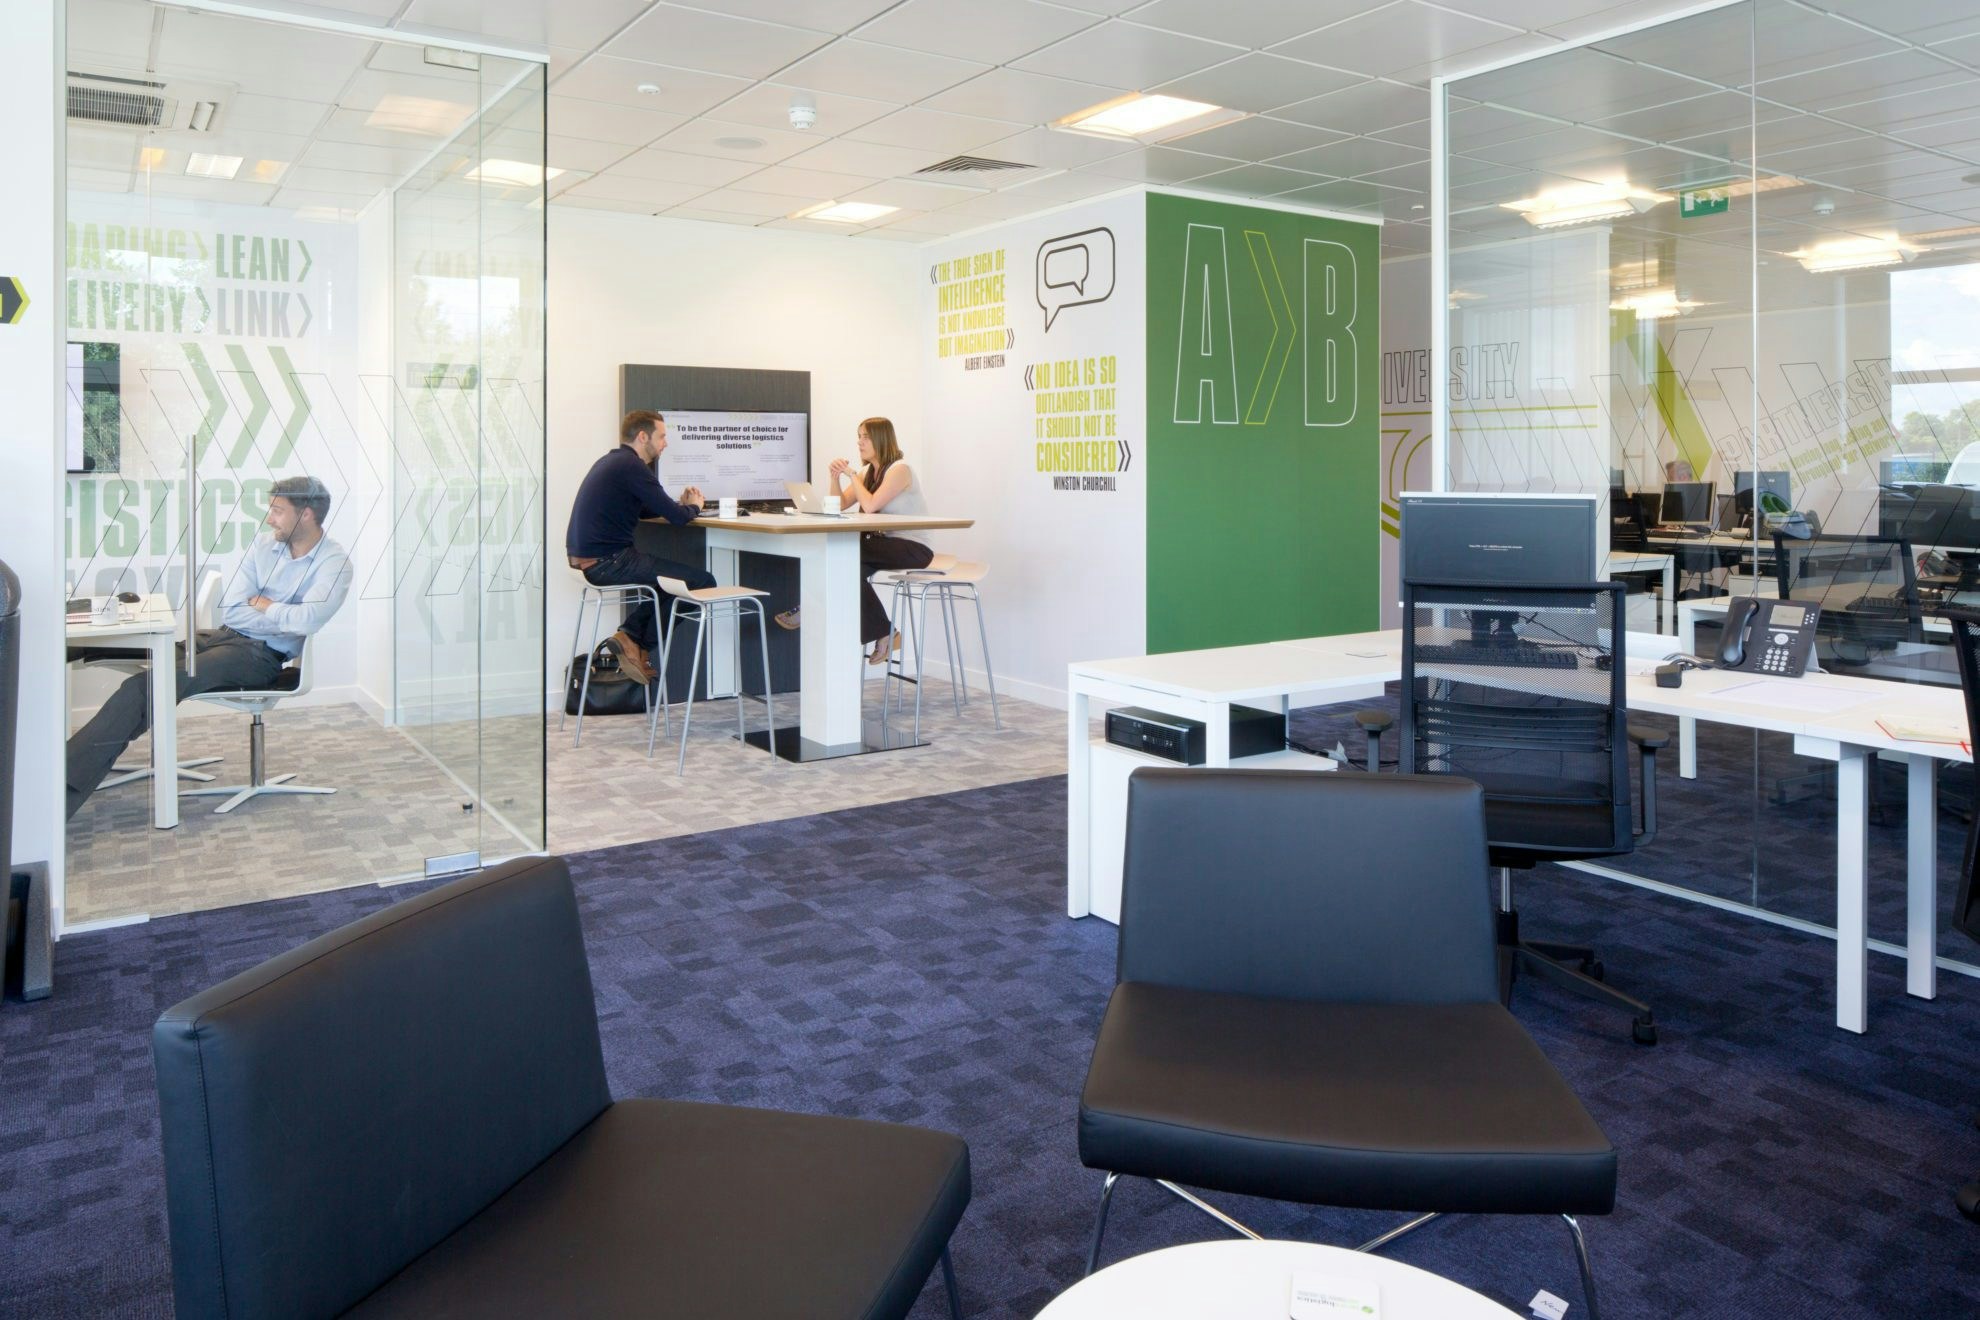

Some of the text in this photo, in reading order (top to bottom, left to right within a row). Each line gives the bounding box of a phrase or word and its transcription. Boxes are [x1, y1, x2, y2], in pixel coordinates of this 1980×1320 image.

[216, 233, 290, 282] LEAN
[938, 249, 1005, 282] THE TRUE SIGN OF
[939, 274, 1005, 312] INTELLIGENCE
[217, 287, 291, 338] LINK
[939, 305, 1005, 335] IS NOT KNOWLEDGE
[1173, 222, 1358, 426] A B
[939, 329, 1005, 358] BUT IMAGINATION
[965, 354, 1005, 371] ALBERT EINSTEIN
[1036, 355, 1116, 390] NO IDEA IS SO
[1383, 342, 1520, 405] IVESITY
[1036, 388, 1116, 414] OUTLANDISH THAT
[1036, 414, 1116, 438] IT SHOULD NOT BE
[1036, 440, 1117, 472] CONSIDERED
[1053, 476, 1117, 491] WINSTON CHURCHILL
